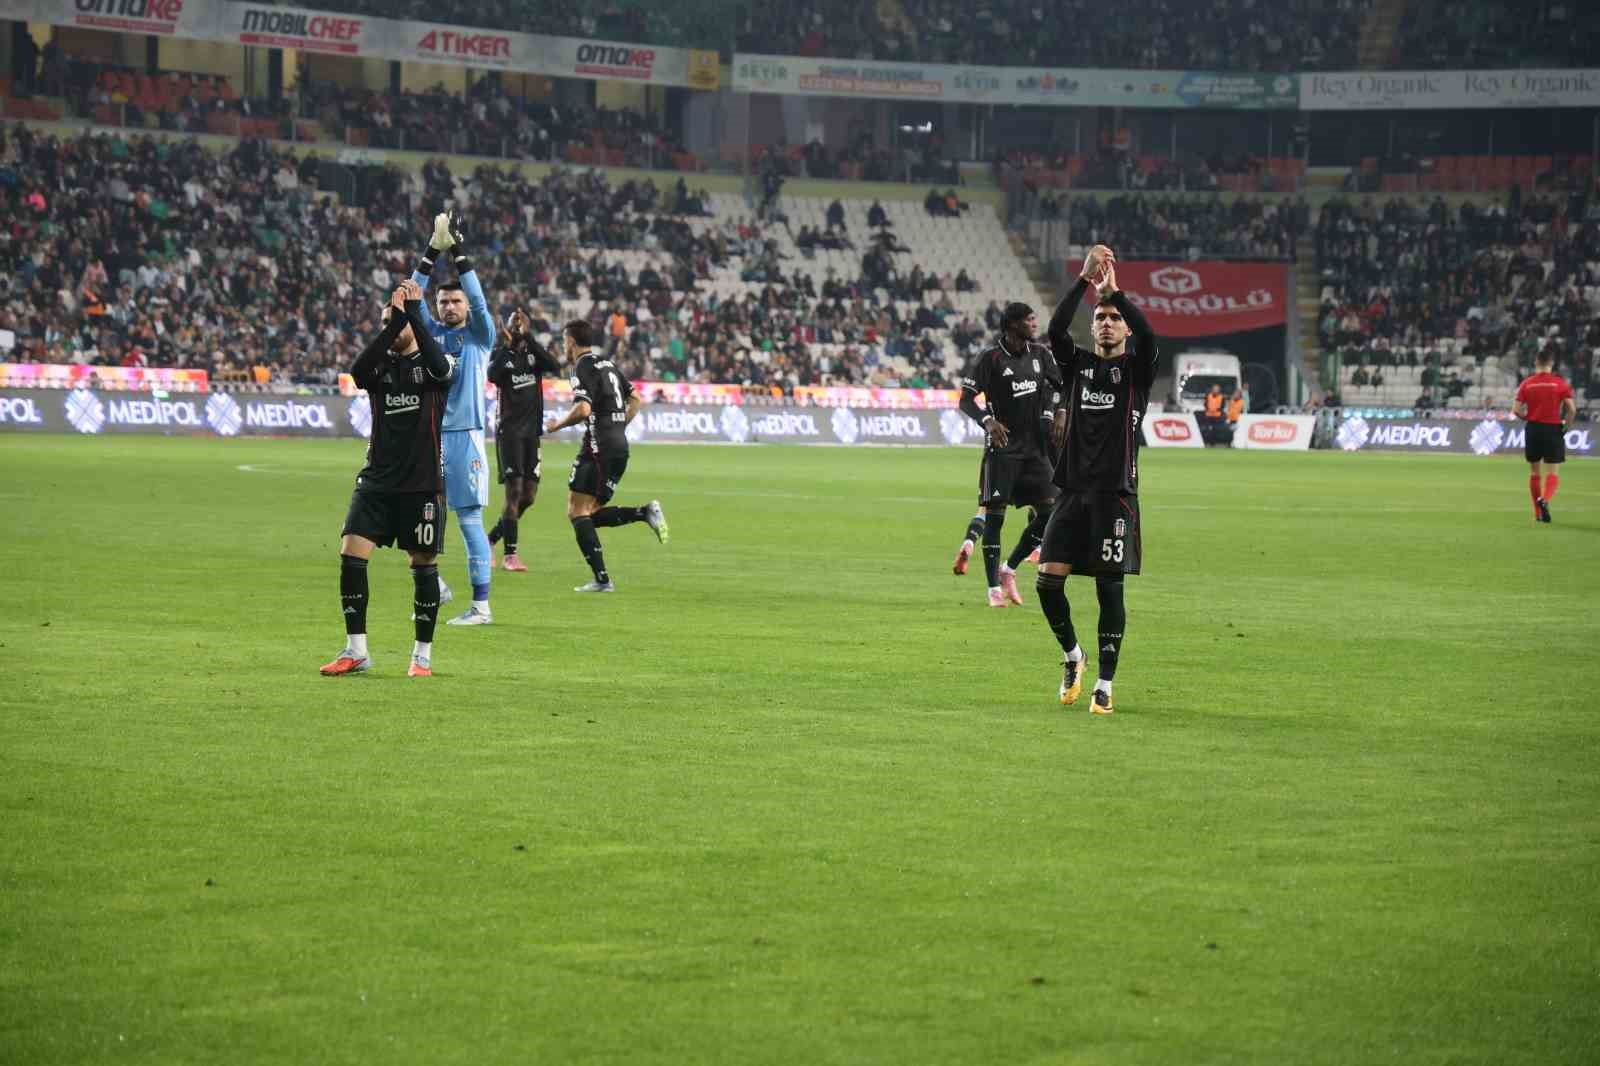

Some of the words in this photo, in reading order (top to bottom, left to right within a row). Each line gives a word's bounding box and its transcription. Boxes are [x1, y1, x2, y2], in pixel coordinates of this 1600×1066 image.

[1011, 379, 1037, 391] beko
[1081, 387, 1116, 404] beko
[414, 524, 433, 546] 10
[1102, 538, 1124, 563] 53
